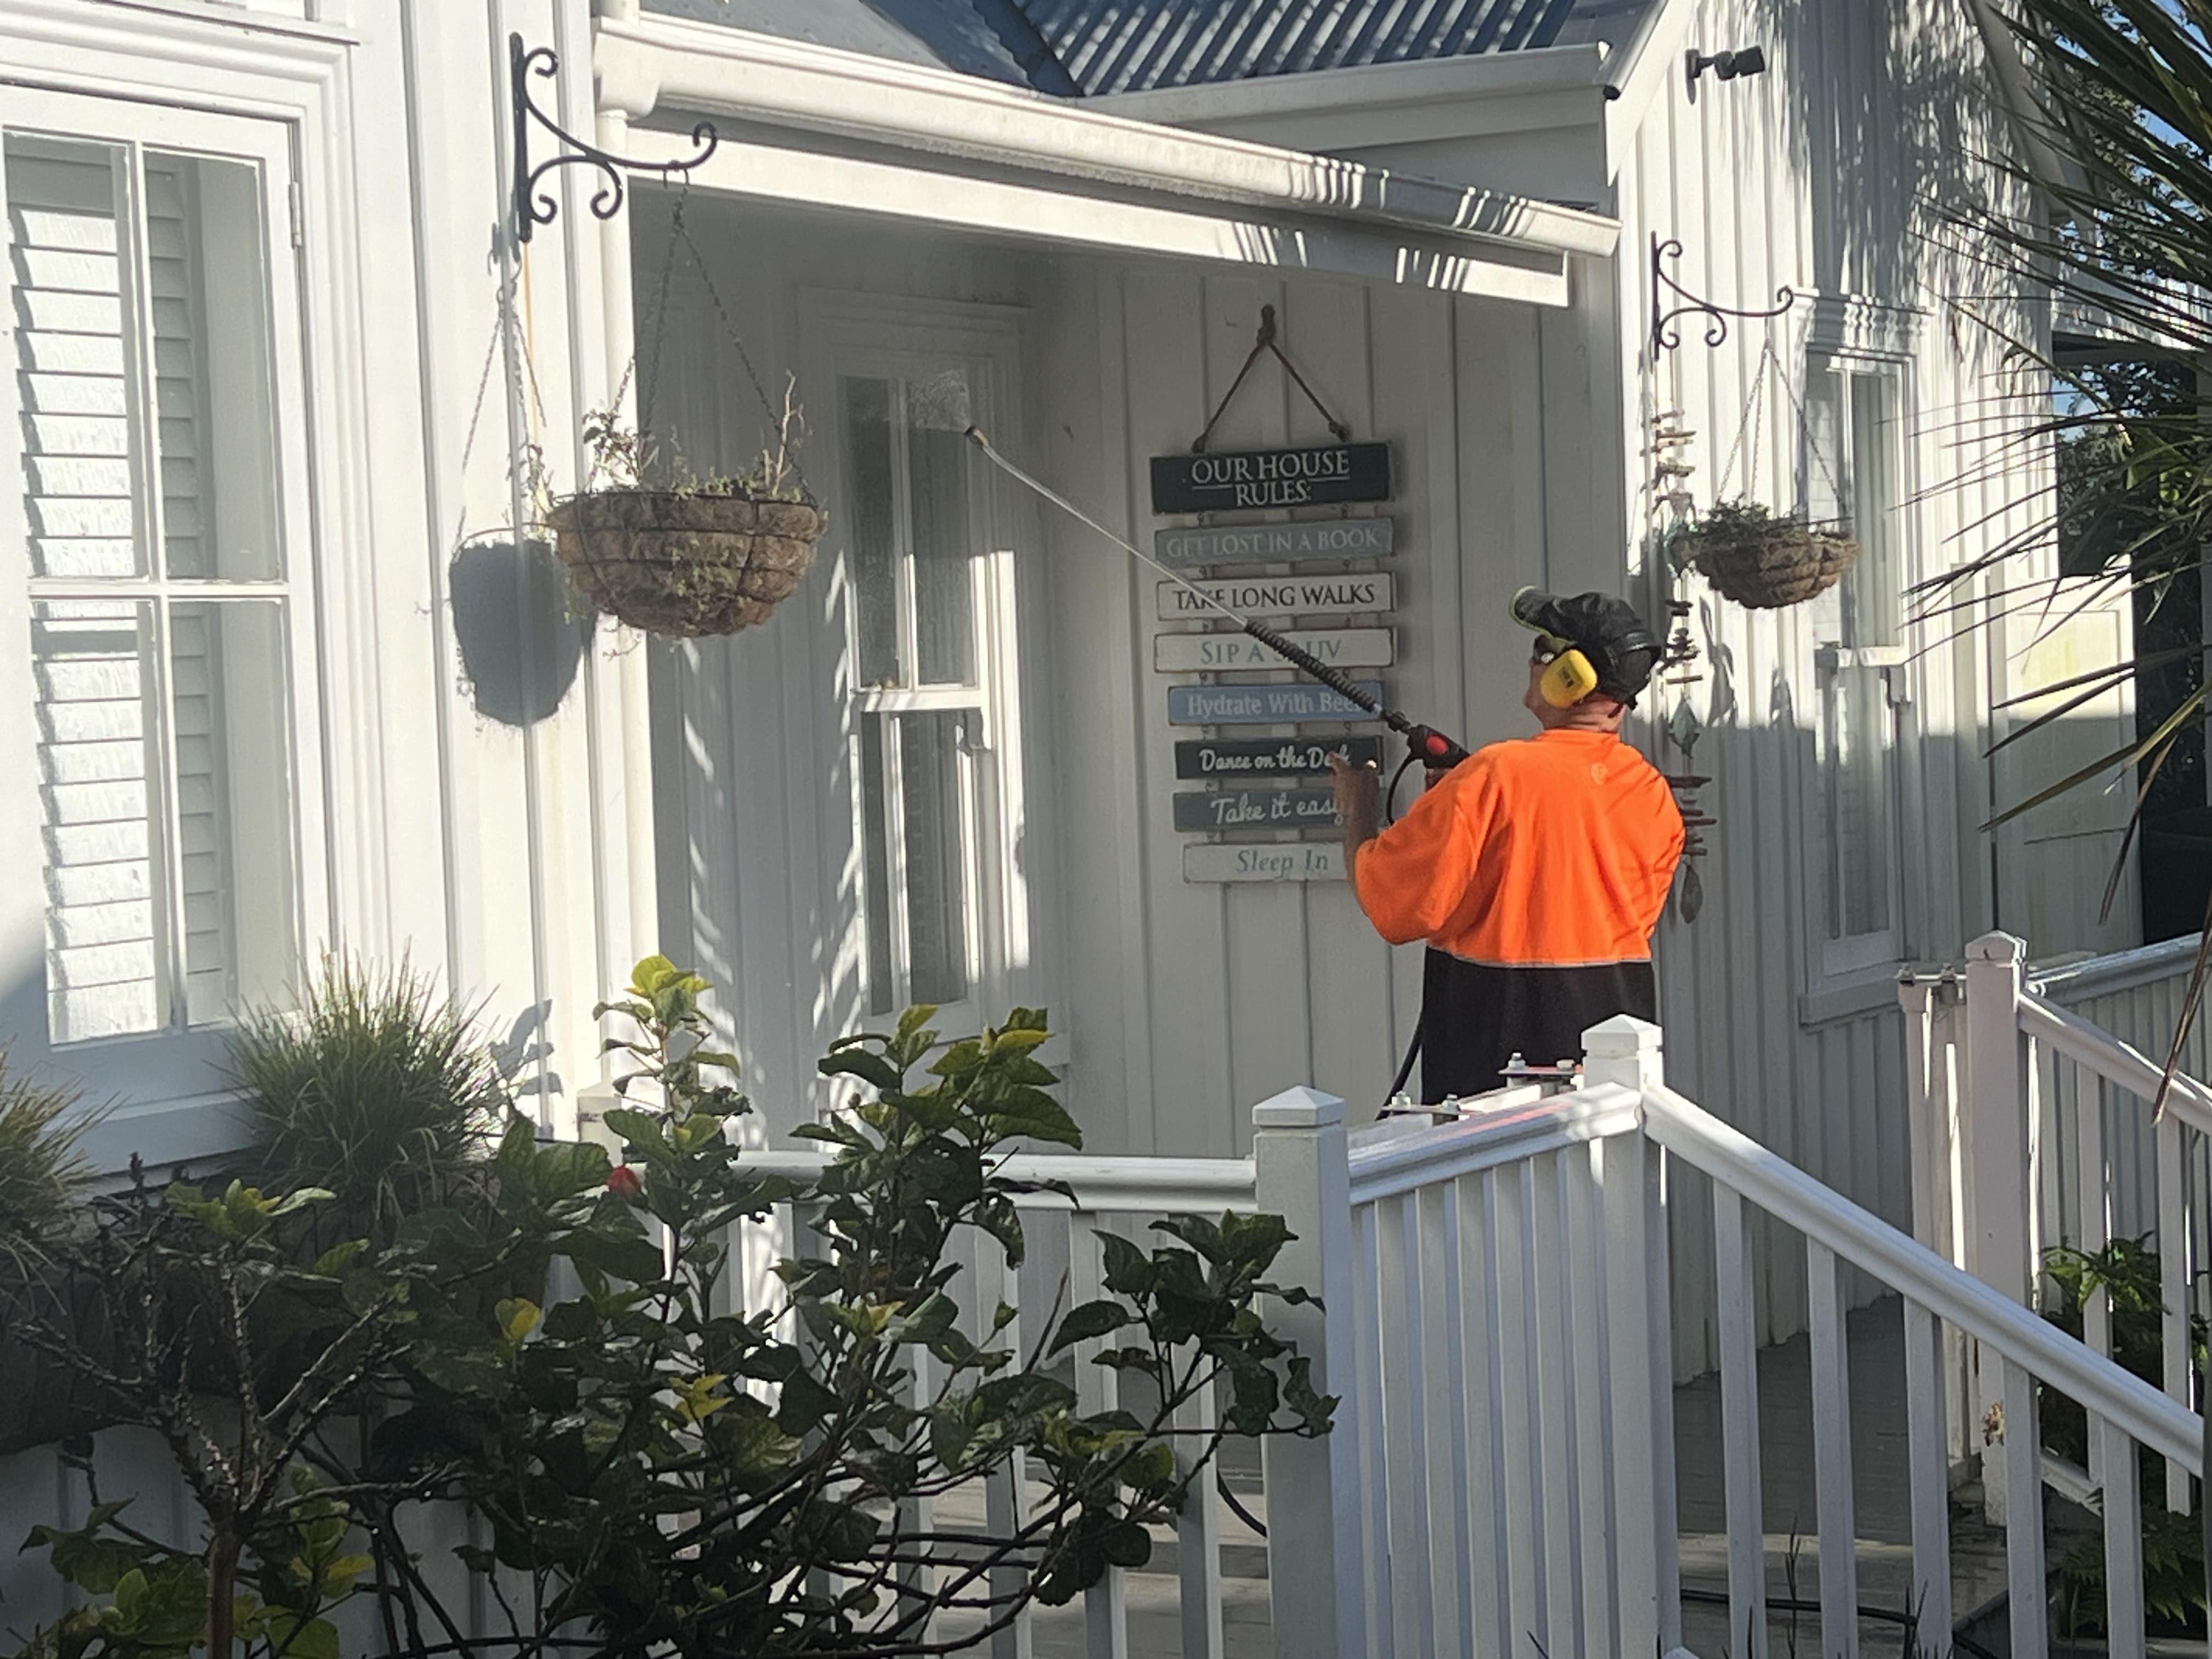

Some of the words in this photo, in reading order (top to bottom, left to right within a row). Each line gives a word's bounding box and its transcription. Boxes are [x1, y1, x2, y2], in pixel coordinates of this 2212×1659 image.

[1192, 458, 1253, 484] OUR
[1257, 451, 1350, 479] HOUSE
[1166, 537, 1207, 557] GET
[1212, 533, 1264, 556] LOST
[1268, 531, 1292, 552] IN
[1297, 532, 1312, 551] A
[1318, 528, 1381, 550] BOOK
[1232, 586, 1295, 608] LONG
[1301, 583, 1375, 606] WALKS
[1200, 640, 1240, 665] SIP
[1247, 643, 1265, 662] A
[1187, 693, 1262, 719] Hydrate
[1268, 692, 1314, 714] With
[1198, 748, 1253, 771] Dance
[1254, 755, 1276, 769] on
[1276, 745, 1307, 769] the
[1210, 792, 1266, 825] Take
[1270, 792, 1292, 820] it
[1236, 849, 1294, 879] Sleep
[1305, 849, 1329, 871] In
